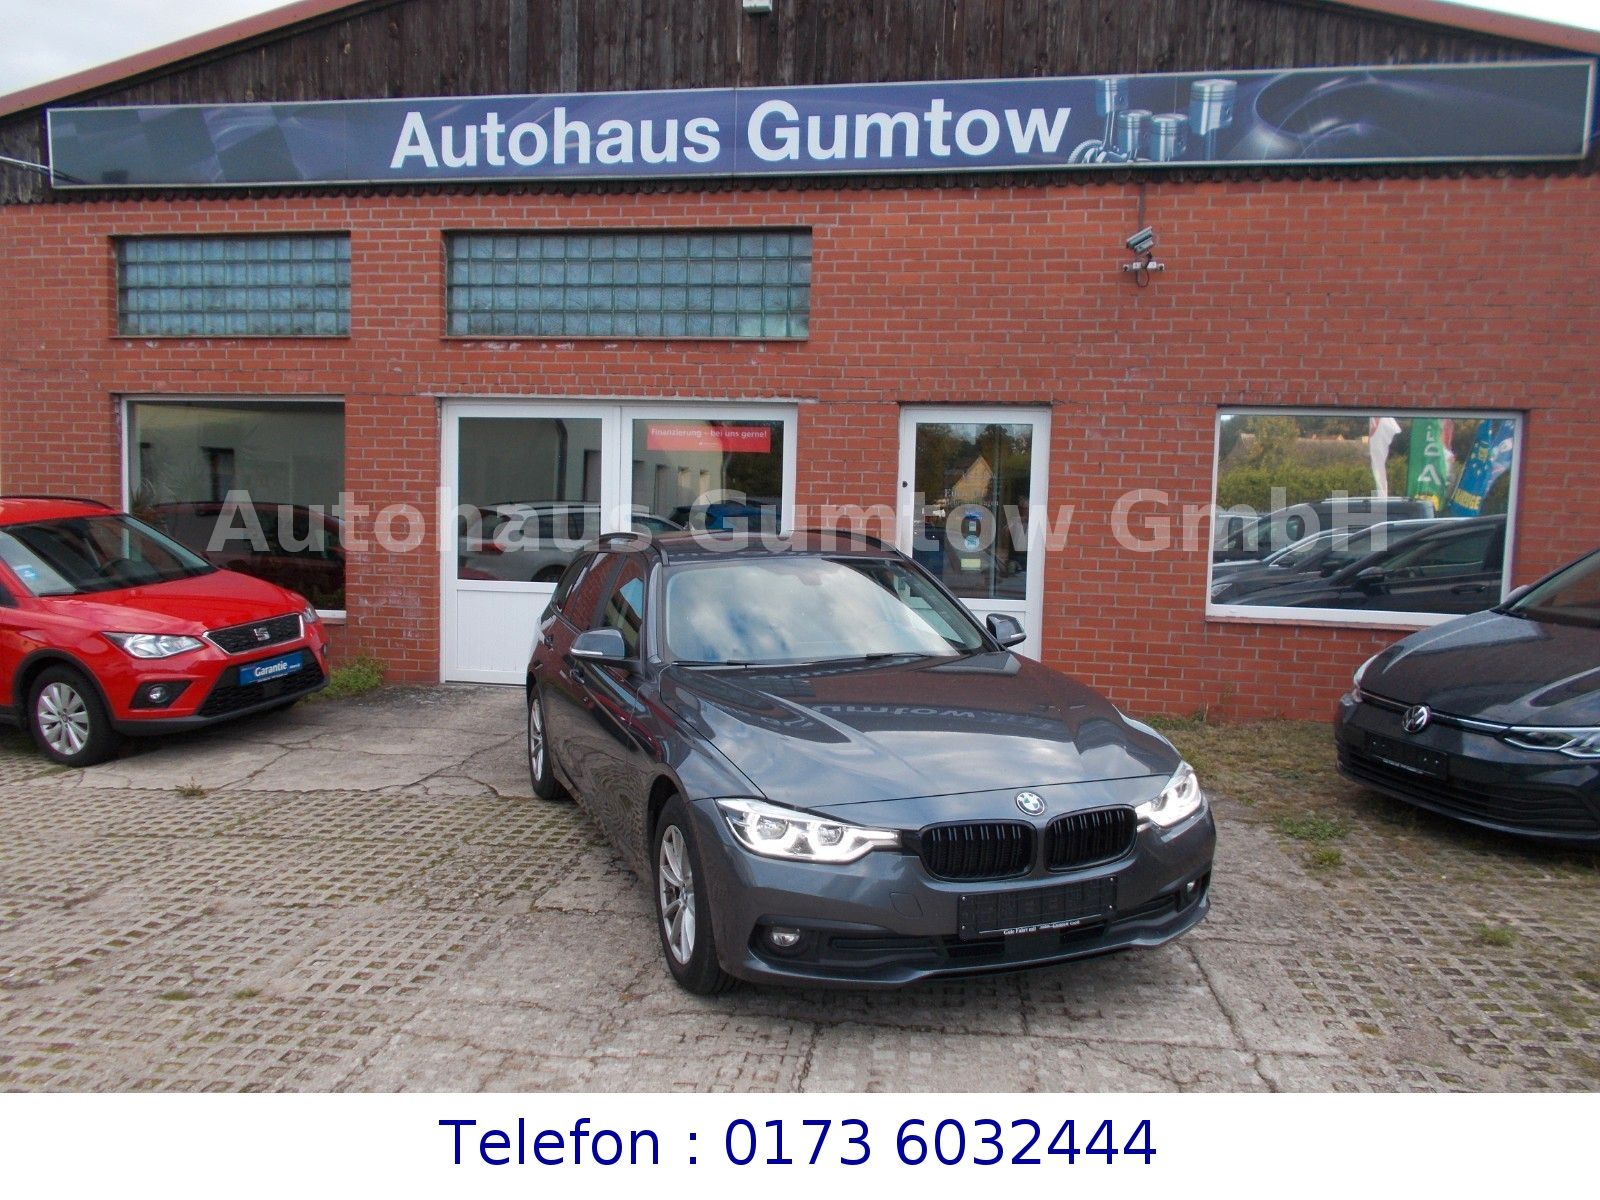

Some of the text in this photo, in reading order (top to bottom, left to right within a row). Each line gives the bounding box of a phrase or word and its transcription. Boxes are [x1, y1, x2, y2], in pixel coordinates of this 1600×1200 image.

[390, 98, 1071, 168] Autohaus Gumtow
[651, 428, 703, 439] Finanzierung
[710, 429, 723, 438] bei
[741, 430, 767, 440] gerne!
[254, 660, 288, 677] Garantie
